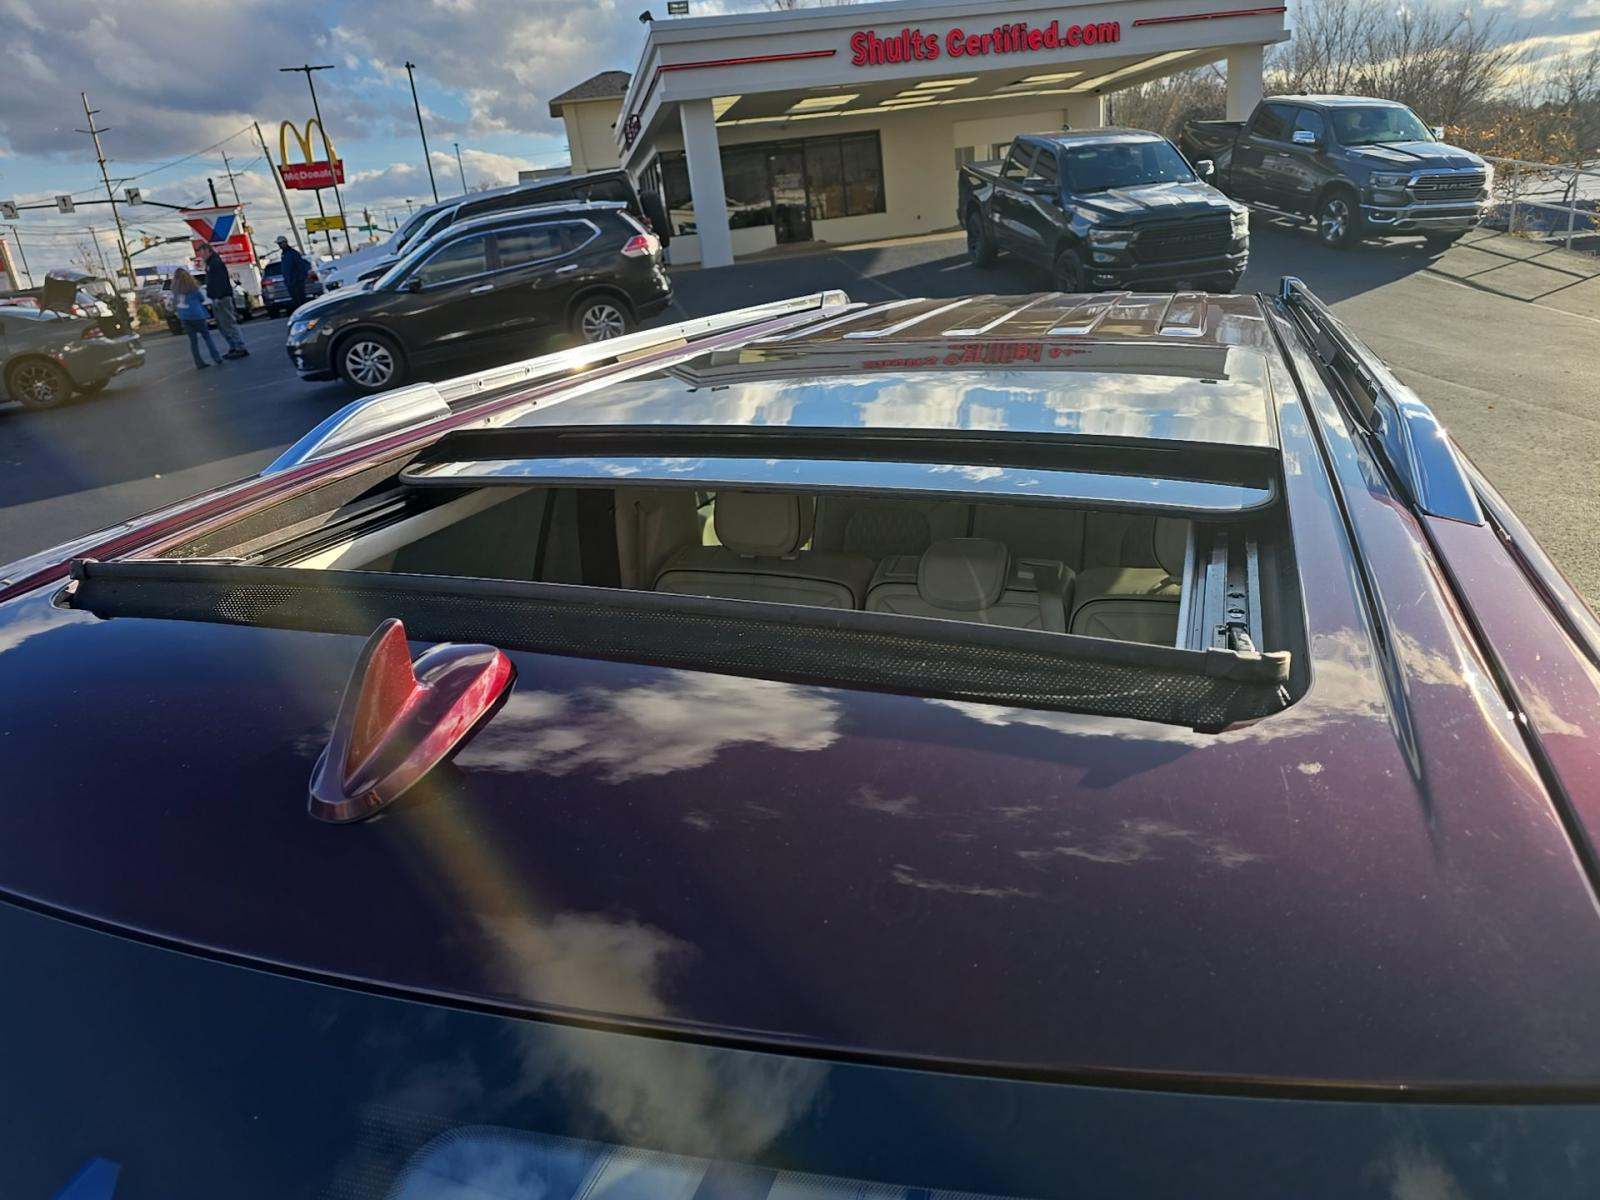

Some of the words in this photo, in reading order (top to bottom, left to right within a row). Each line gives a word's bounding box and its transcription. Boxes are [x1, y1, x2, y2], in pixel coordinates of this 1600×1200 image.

[850, 28, 940, 66] Shults
[946, 20, 1121, 57] Certified.com
[283, 168, 342, 181] McDonalds
